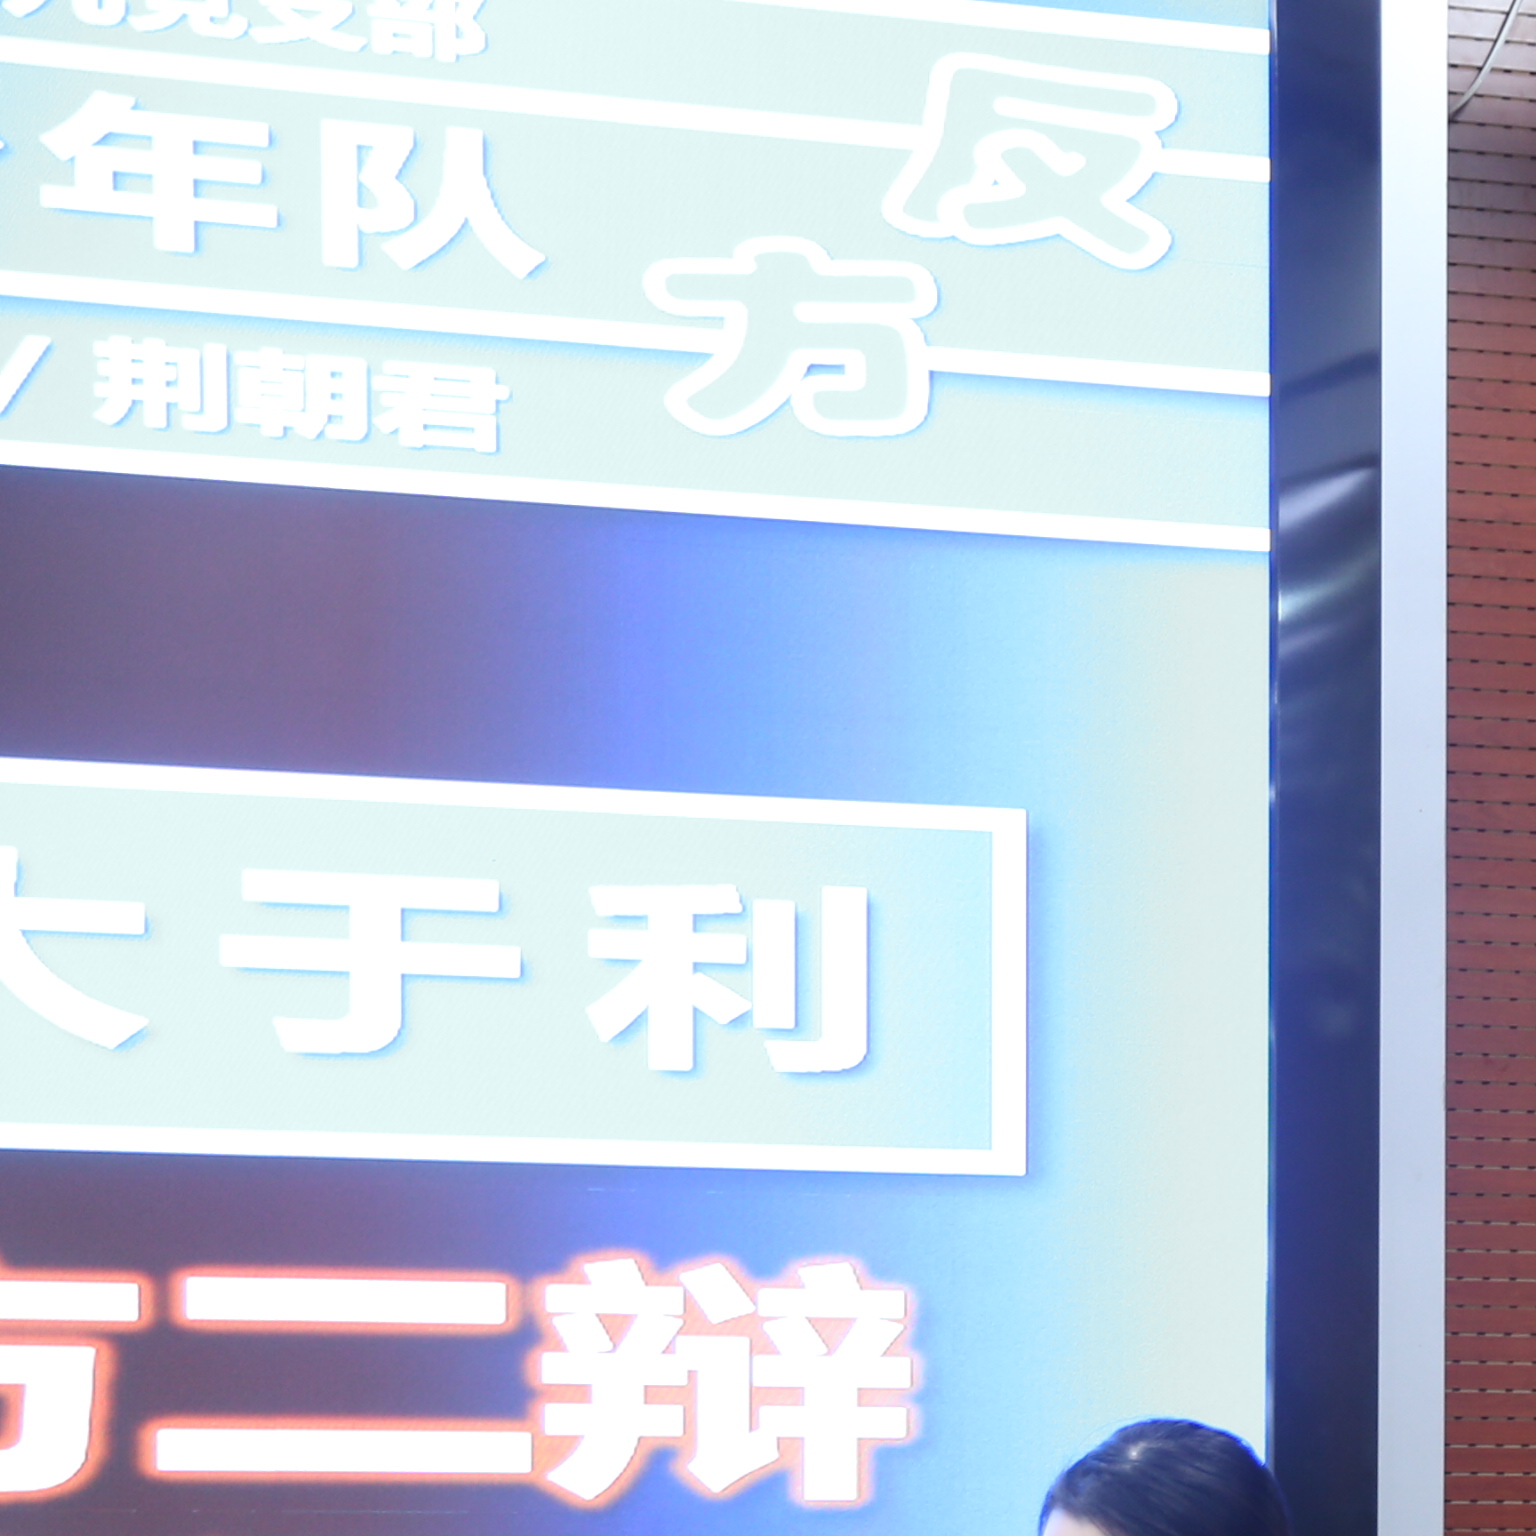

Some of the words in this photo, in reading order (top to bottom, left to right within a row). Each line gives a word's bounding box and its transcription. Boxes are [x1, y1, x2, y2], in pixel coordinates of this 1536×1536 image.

[0, 89, 548, 280] 年队
[93, 335, 512, 454] 荆朝君
